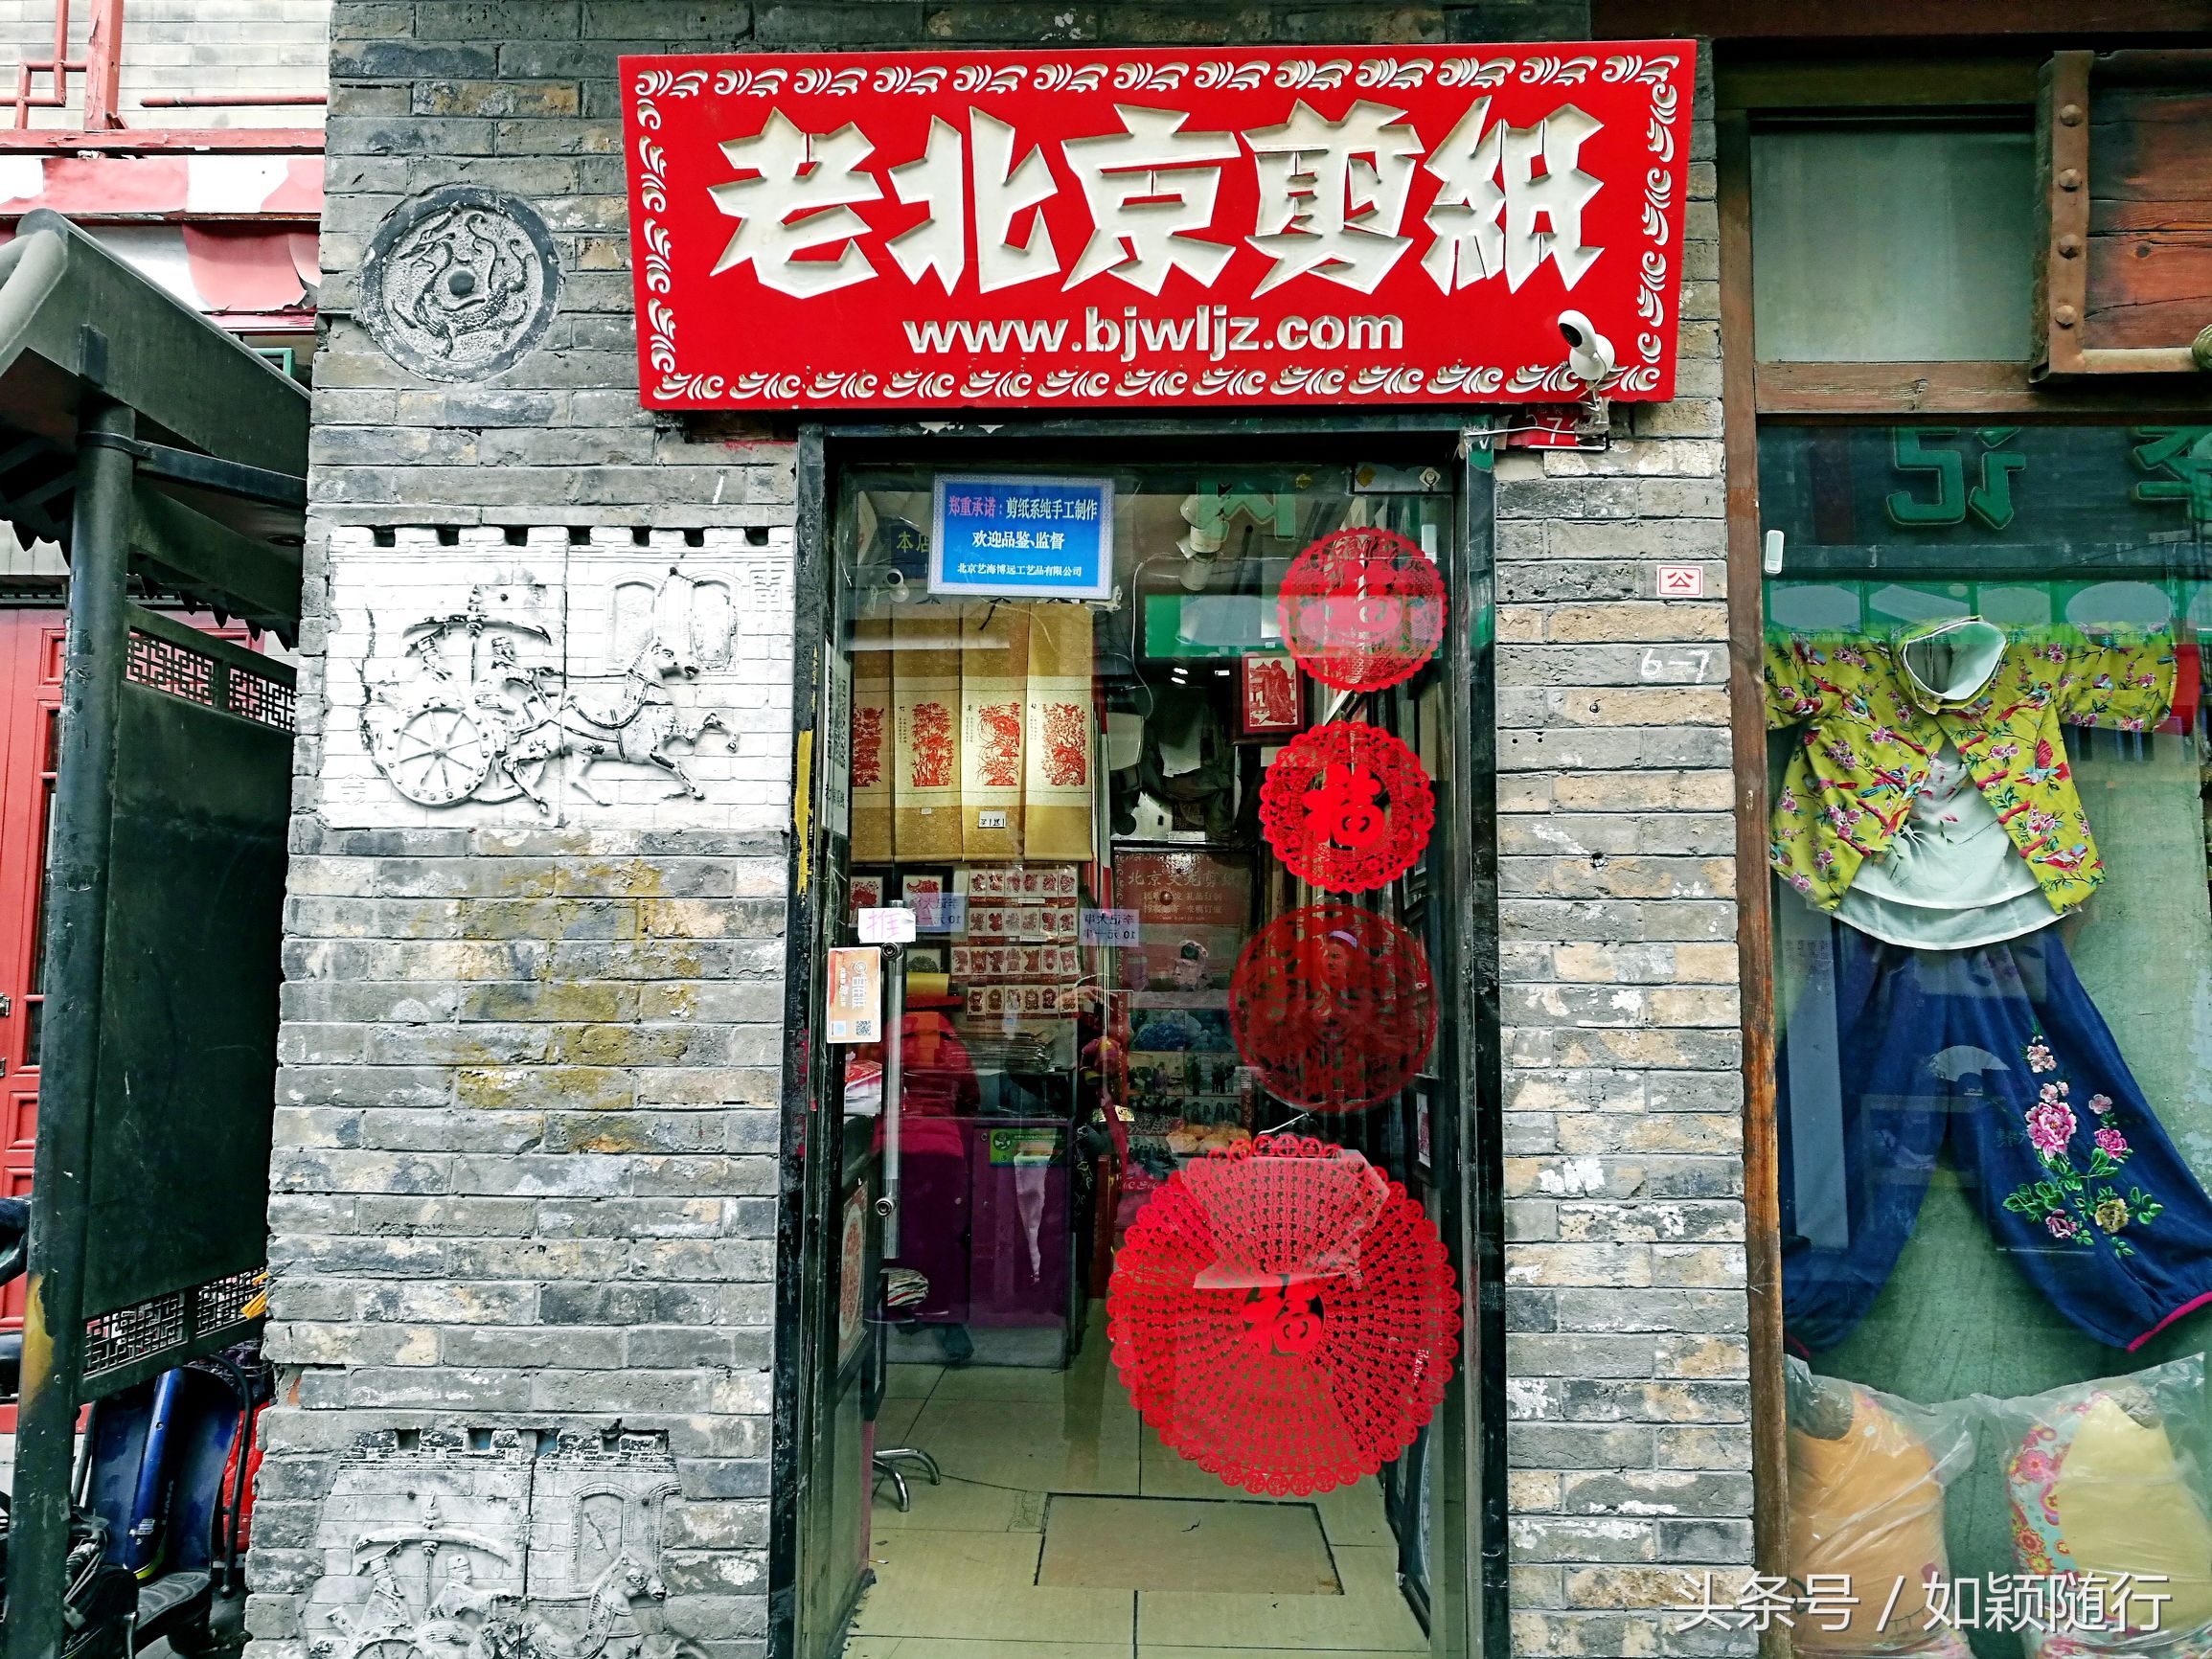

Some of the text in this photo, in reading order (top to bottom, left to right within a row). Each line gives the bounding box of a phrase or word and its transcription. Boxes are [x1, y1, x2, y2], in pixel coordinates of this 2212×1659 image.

[902, 305, 1403, 362] www.bjwljz.com
[1667, 572, 1695, 588] 公
[866, 910, 901, 941] 推
